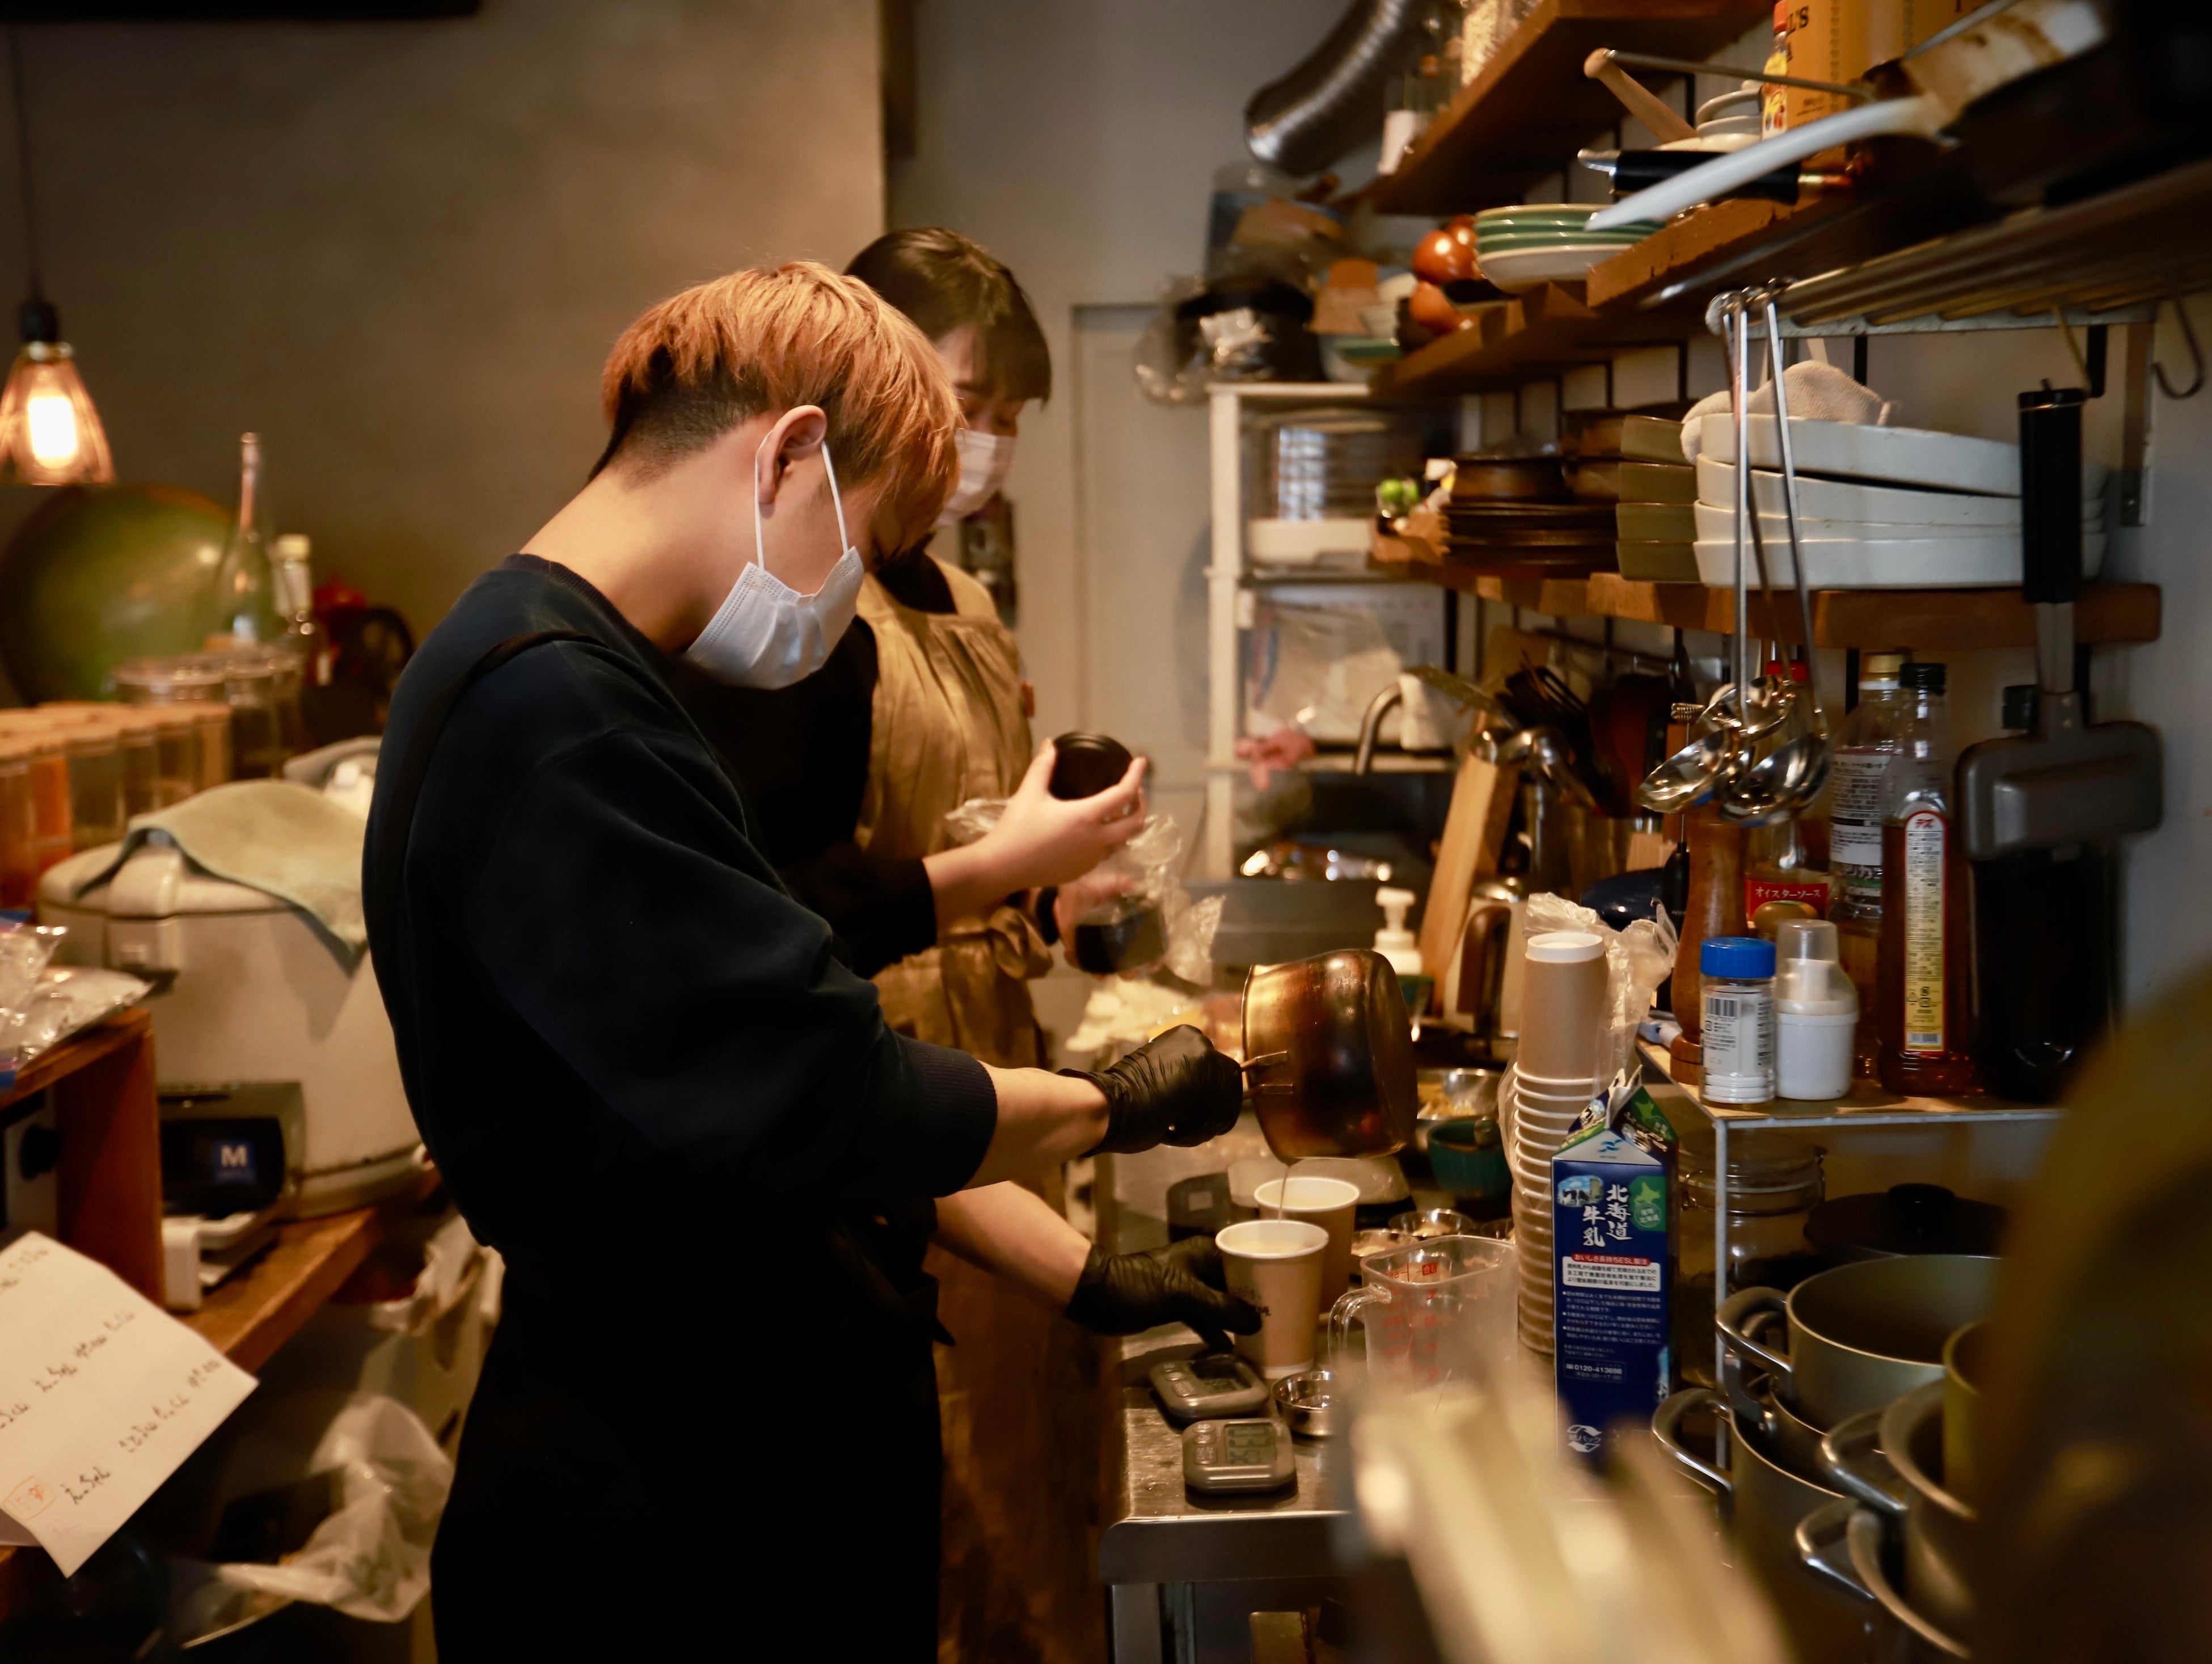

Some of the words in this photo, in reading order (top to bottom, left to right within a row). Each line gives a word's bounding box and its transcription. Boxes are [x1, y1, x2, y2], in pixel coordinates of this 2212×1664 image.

[1755, 887, 1821, 899] オイスターソース
[221, 1144, 247, 1167] M
[1582, 1206, 1606, 1247] 牛乳
[1606, 1184, 1633, 1240] 北海道
